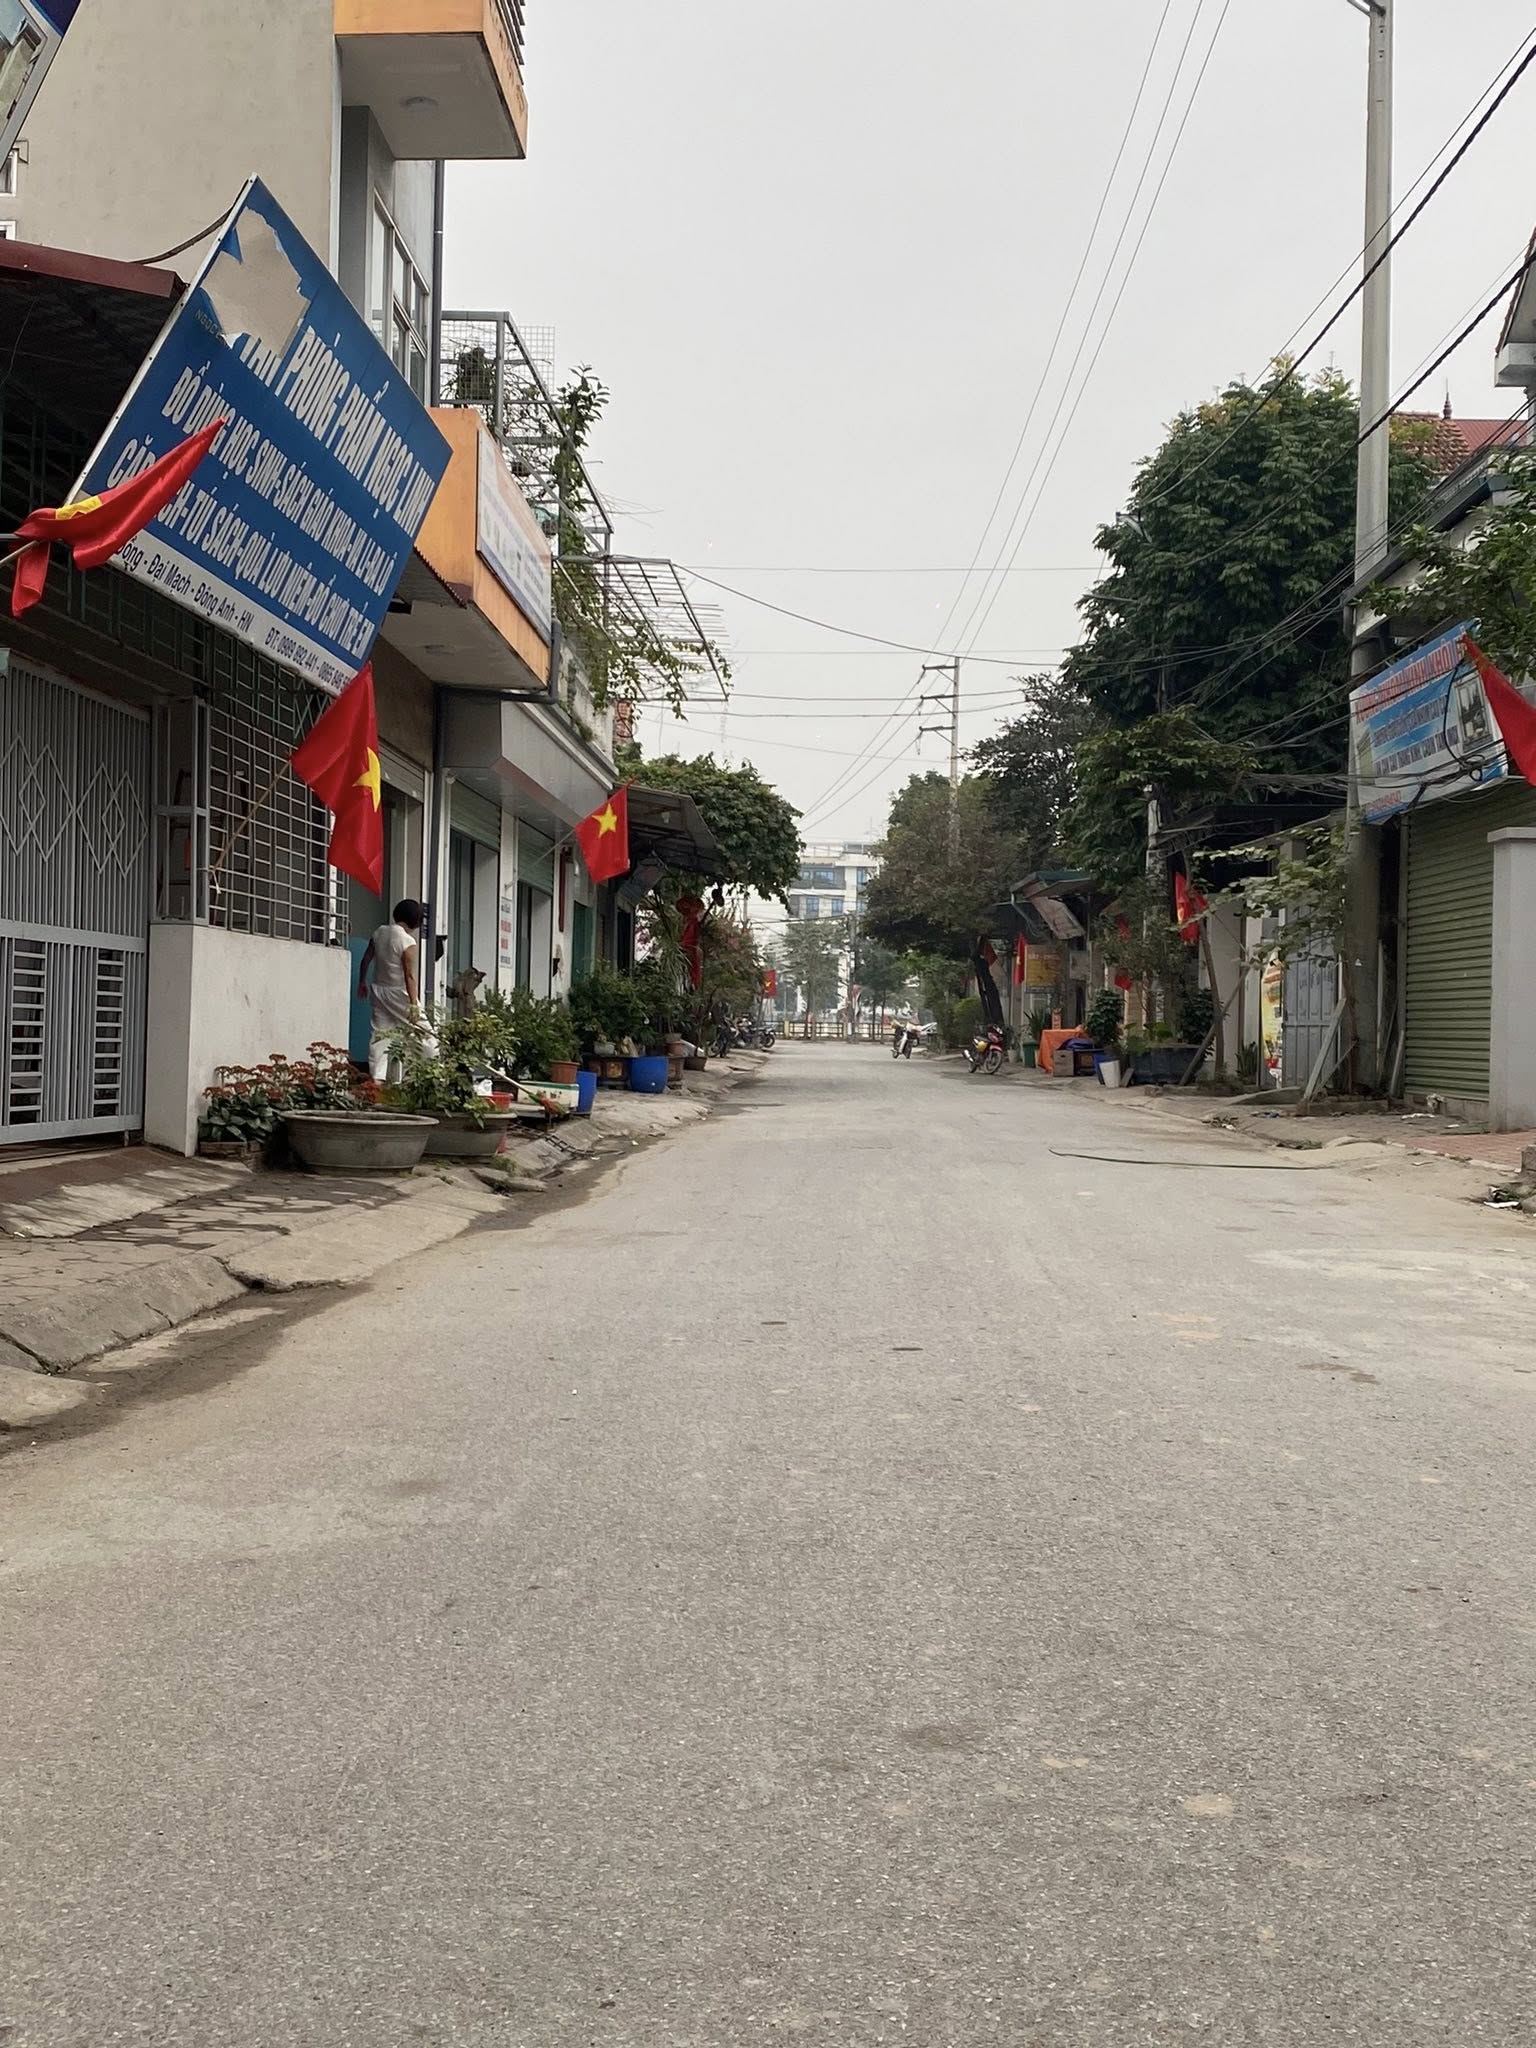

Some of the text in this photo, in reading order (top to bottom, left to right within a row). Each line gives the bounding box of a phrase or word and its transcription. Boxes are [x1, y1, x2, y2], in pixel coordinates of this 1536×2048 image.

[274, 325, 435, 539] PHÒNG PHẨM NGỌC LINH
[161, 361, 210, 425] ĐỒ
[219, 416, 260, 480] HỌC
[300, 488, 335, 542] GIÁO
[374, 552, 398, 596] LÔ
[147, 554, 169, 582] Đại
[163, 564, 191, 595] Mạch
[194, 583, 218, 617] Đông
[215, 596, 235, 622] Anh
[237, 608, 255, 633] HN
[257, 547, 293, 599] LƯU
[318, 592, 350, 640] CHƠI
[338, 601, 368, 652] TRẺ
[351, 617, 375, 660] EM
